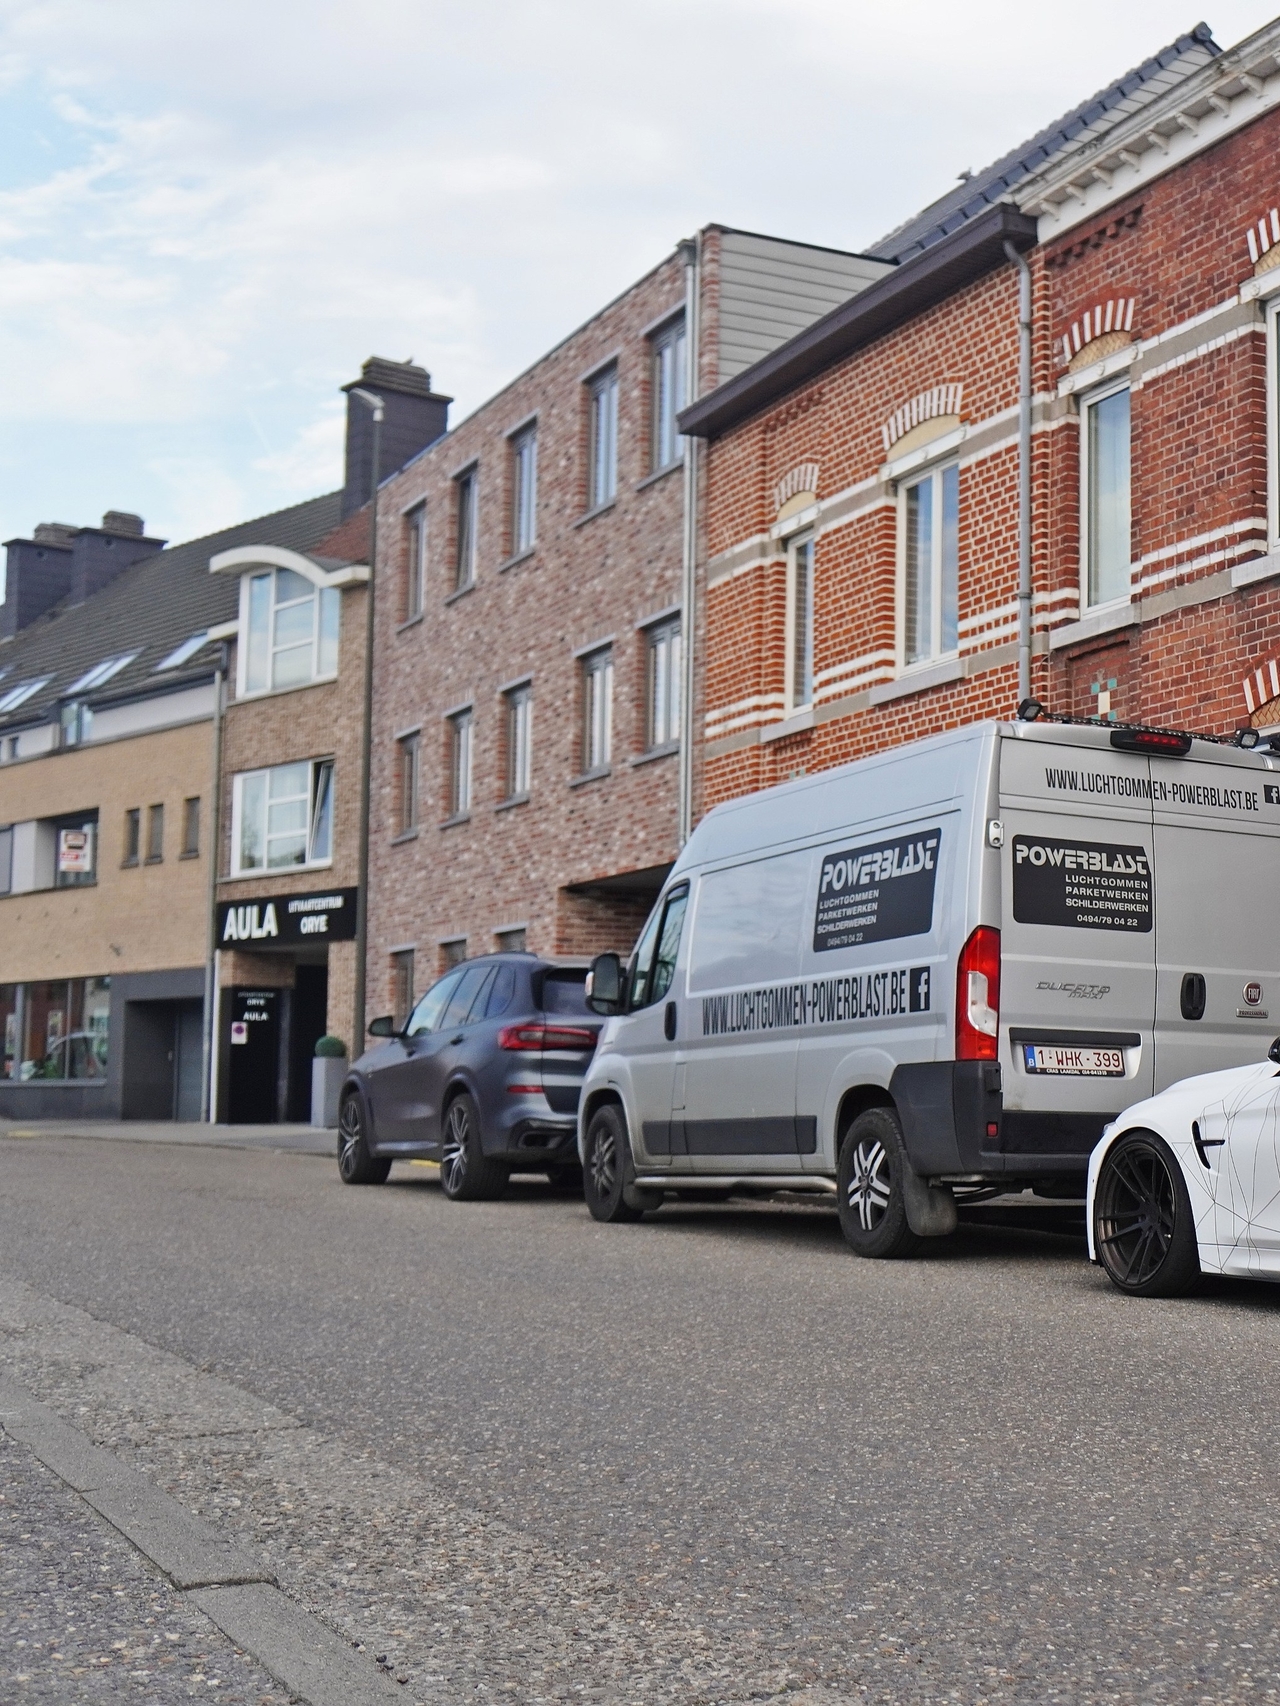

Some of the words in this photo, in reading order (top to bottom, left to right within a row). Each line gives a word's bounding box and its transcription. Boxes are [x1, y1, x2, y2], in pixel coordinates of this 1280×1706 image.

[1045, 767, 1259, 812] WWW.LUCHTGOMMEN-POWERBLAST.BE
[821, 838, 938, 894] POWERBLAST
[1015, 843, 1148, 876] POWERBLAST
[1065, 874, 1149, 889] LUCHTGOMMEN
[819, 888, 881, 910] LUCHTGOMMEN
[1065, 886, 1149, 901] PARKETWERKEN
[817, 901, 879, 922] PARKETWERKEN
[1065, 898, 1149, 913] SCHILDERWERKEN
[222, 903, 279, 942] AULA
[300, 914, 328, 934] ORYE
[816, 914, 877, 935] SCHILDERWERKEN
[1076, 914, 1113, 925] 0494/79
[1114, 917, 1126, 926] 04
[1126, 918, 1139, 927] 22
[848, 933, 856, 943] 04
[856, 932, 864, 941] 22
[1035, 982, 1111, 994] DUCATO
[702, 969, 907, 1036] WWW.LUCHTGOMMEN-POWERBLAST.BE
[1038, 1050, 1121, 1068] 1-WHK-399
